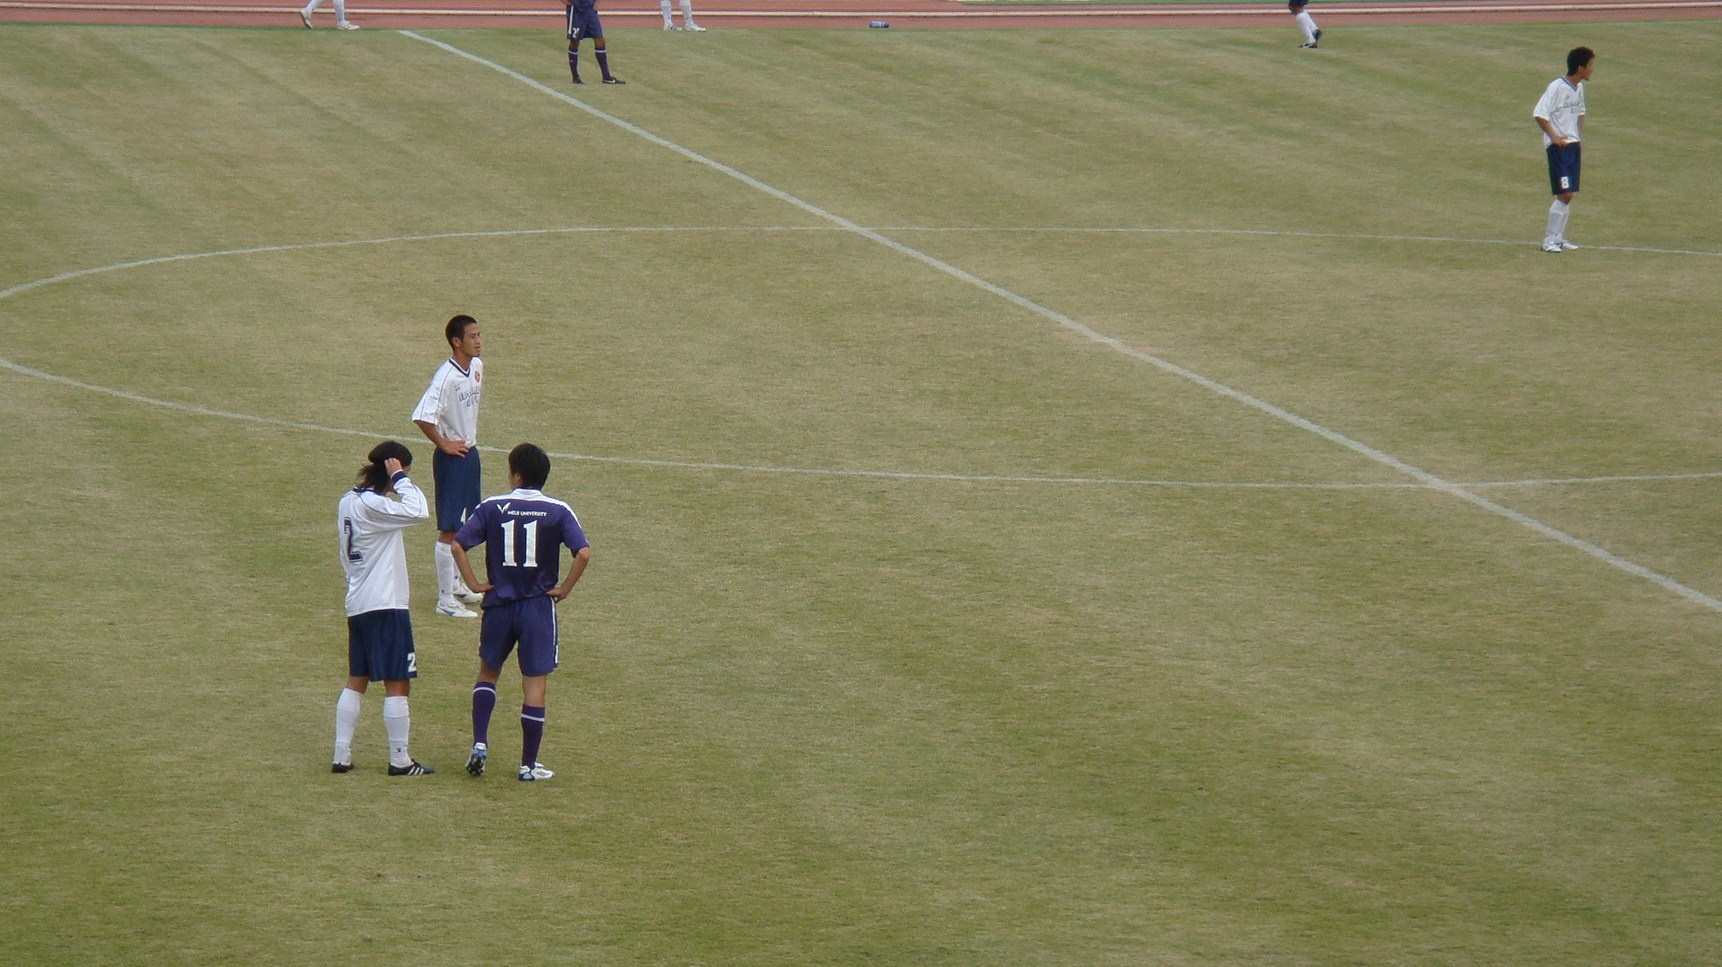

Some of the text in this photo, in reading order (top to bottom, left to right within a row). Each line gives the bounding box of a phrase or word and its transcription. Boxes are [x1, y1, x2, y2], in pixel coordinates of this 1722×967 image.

[1561, 176, 1570, 189] 8
[344, 516, 363, 563] 2
[501, 519, 538, 567] 11
[407, 652, 417, 673] 2
